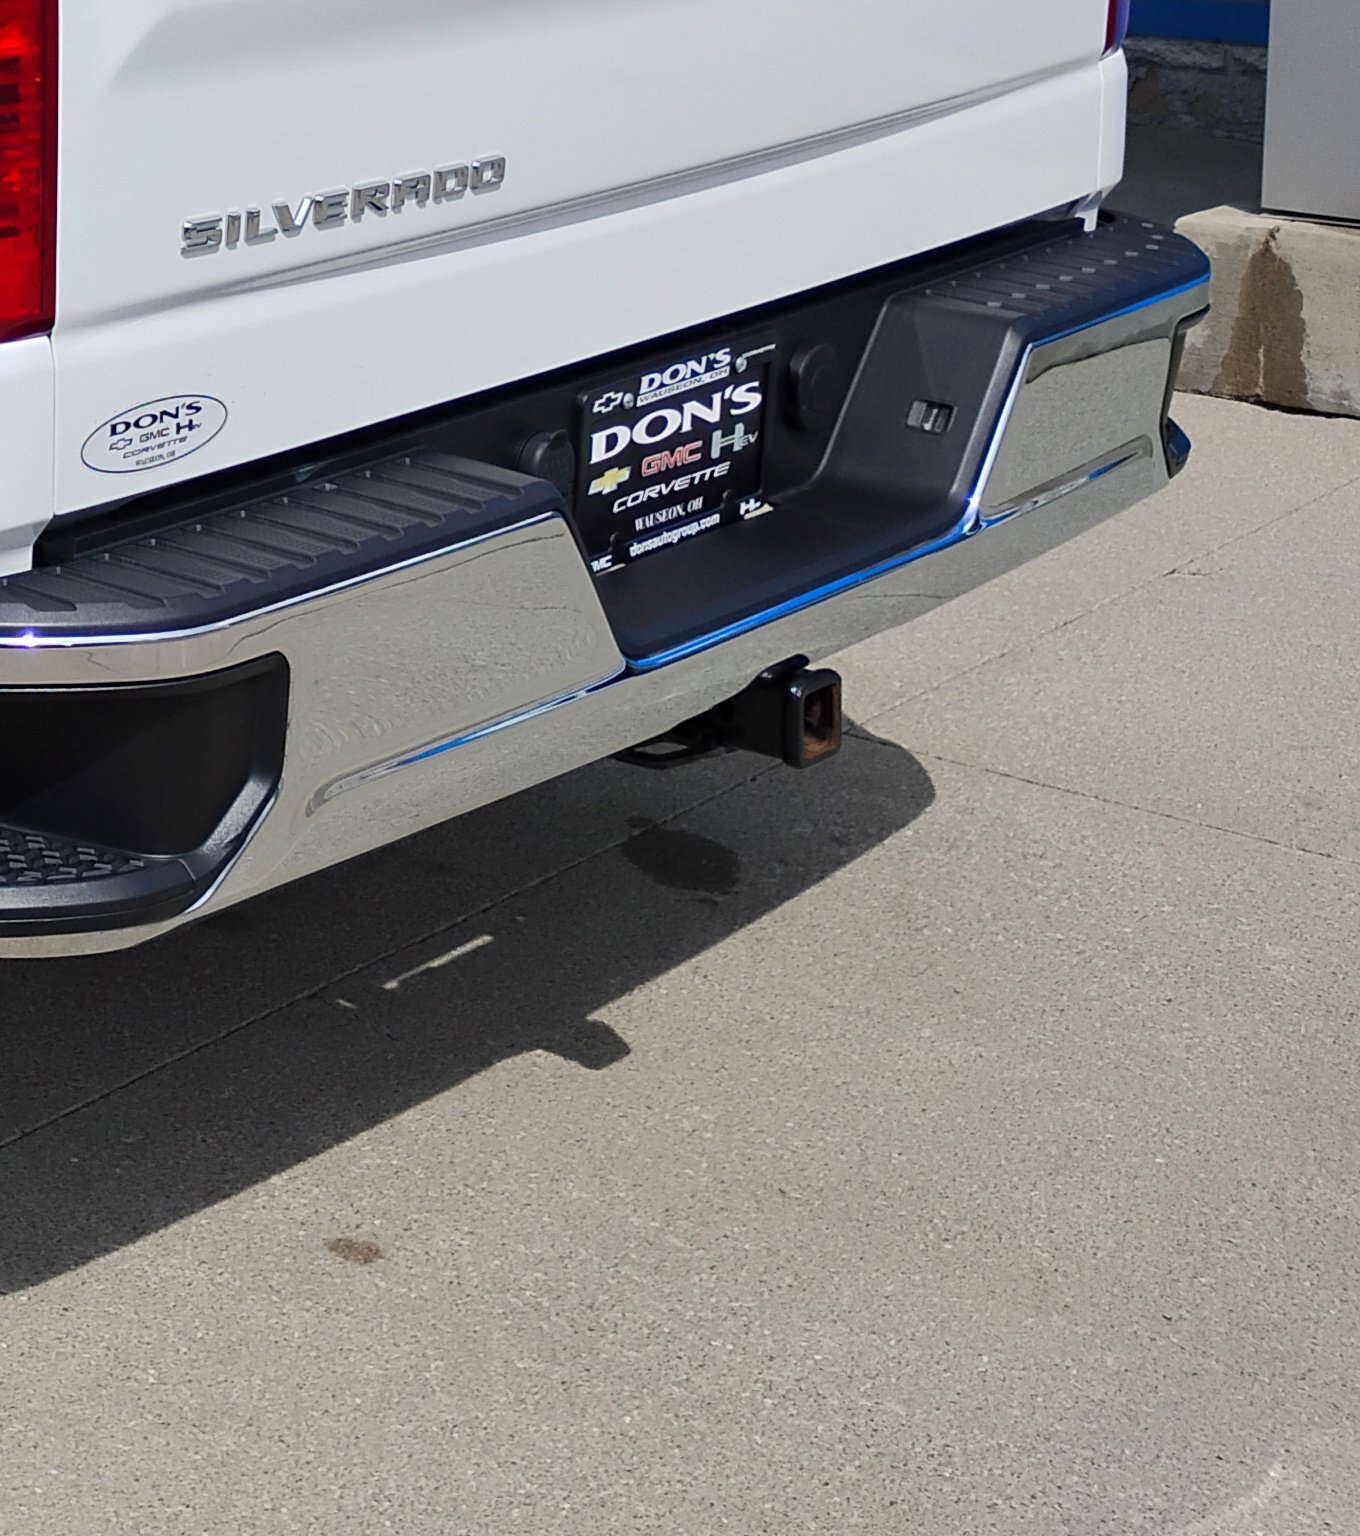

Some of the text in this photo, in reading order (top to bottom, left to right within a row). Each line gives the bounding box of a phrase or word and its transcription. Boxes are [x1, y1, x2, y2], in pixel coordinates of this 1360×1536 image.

[180, 153, 507, 256] SILVERADO
[638, 367, 729, 404] WAUSEON, OH
[639, 348, 731, 395] DON'S
[109, 401, 202, 437] DON'S
[139, 427, 170, 444] GMC
[589, 381, 763, 465] DON'S
[122, 435, 188, 459] CORVETTE
[641, 439, 704, 478] GMC
[612, 461, 732, 514] CORVETTE
[634, 496, 704, 532] WAUSEON, OH
[629, 512, 721, 557] donsautogroup.com
